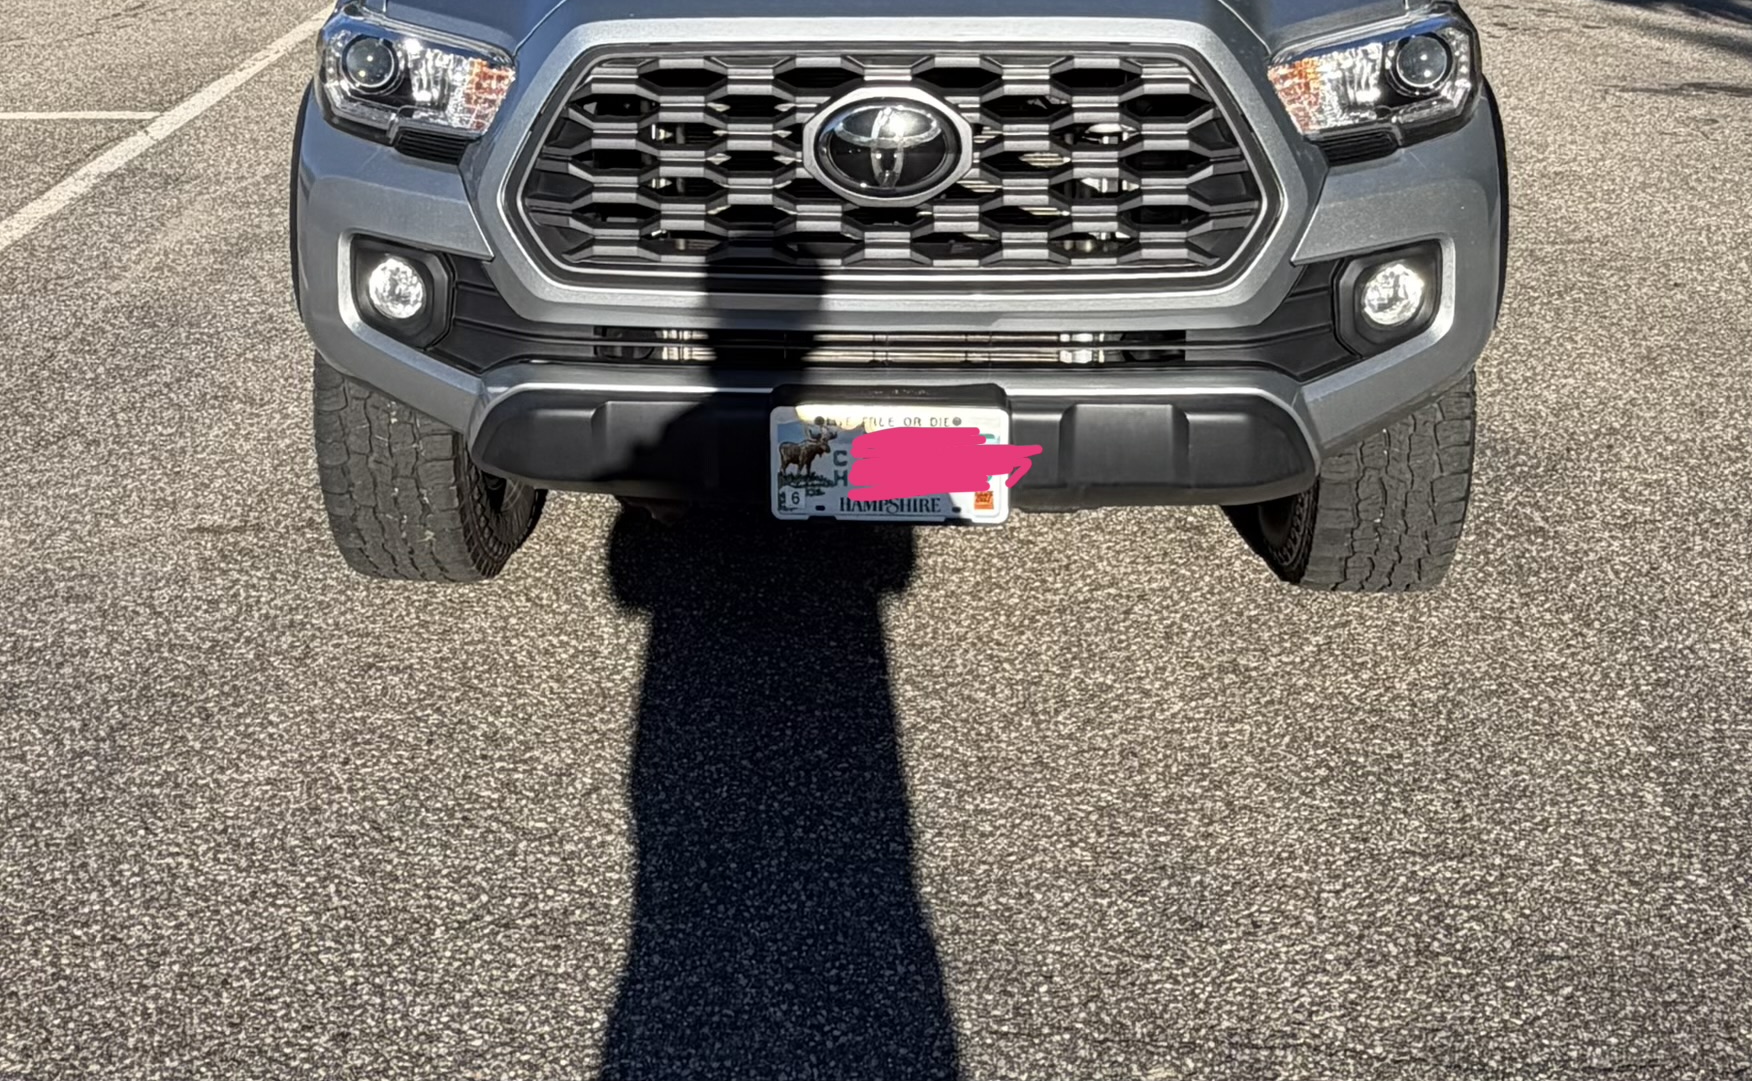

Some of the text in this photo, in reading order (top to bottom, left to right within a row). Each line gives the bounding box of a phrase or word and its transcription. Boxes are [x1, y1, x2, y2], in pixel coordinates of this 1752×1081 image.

[903, 416, 922, 427] OR
[929, 416, 950, 427] DIE
[833, 450, 848, 467] C
[833, 470, 848, 487] H
[791, 491, 800, 505] 6
[840, 496, 942, 514] HAMPSHIRE
